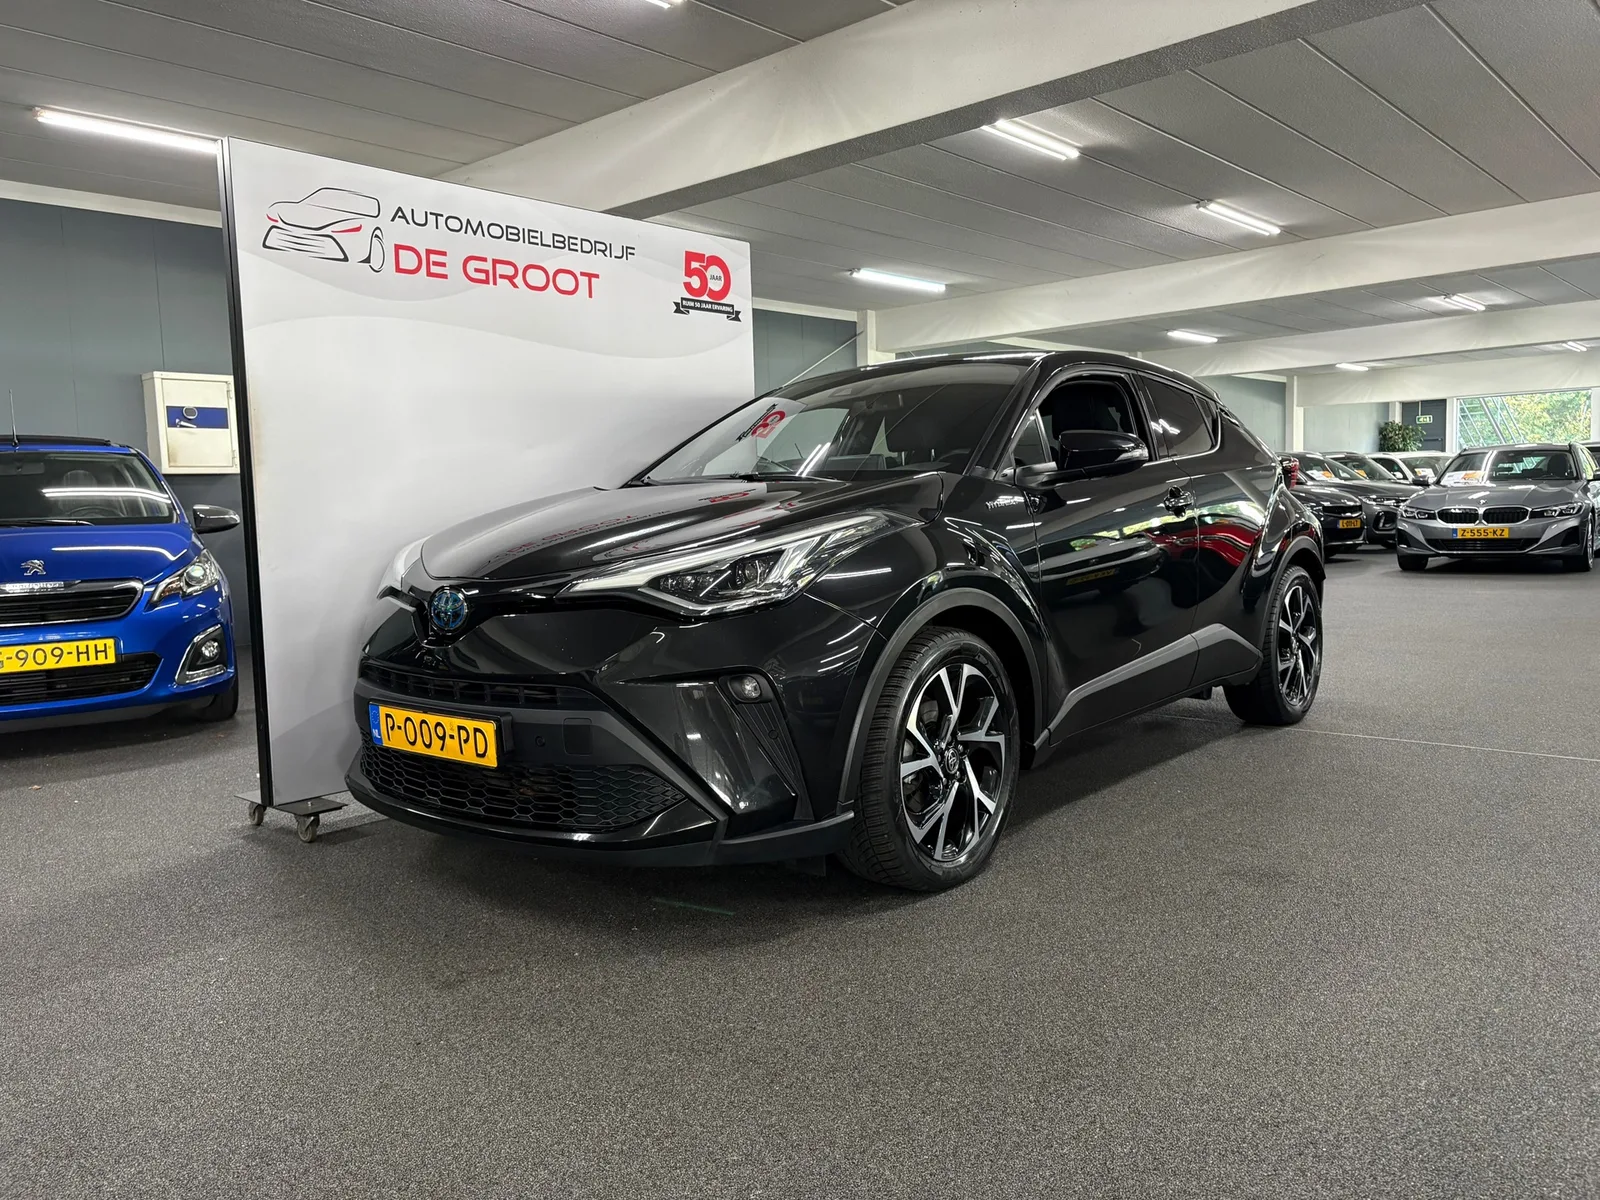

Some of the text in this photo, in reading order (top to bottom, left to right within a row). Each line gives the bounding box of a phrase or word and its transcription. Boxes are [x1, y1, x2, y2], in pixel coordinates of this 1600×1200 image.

[390, 206, 636, 261] AUTOMOBIELBEDRIJF
[393, 243, 600, 299] DE GROOT
[683, 250, 731, 301] 50
[712, 304, 733, 313] ERVARING
[1461, 529, 1505, 537] Z-555-KZ
[0, 643, 108, 668] -909-HH
[372, 712, 488, 759] NL P-009-PD
